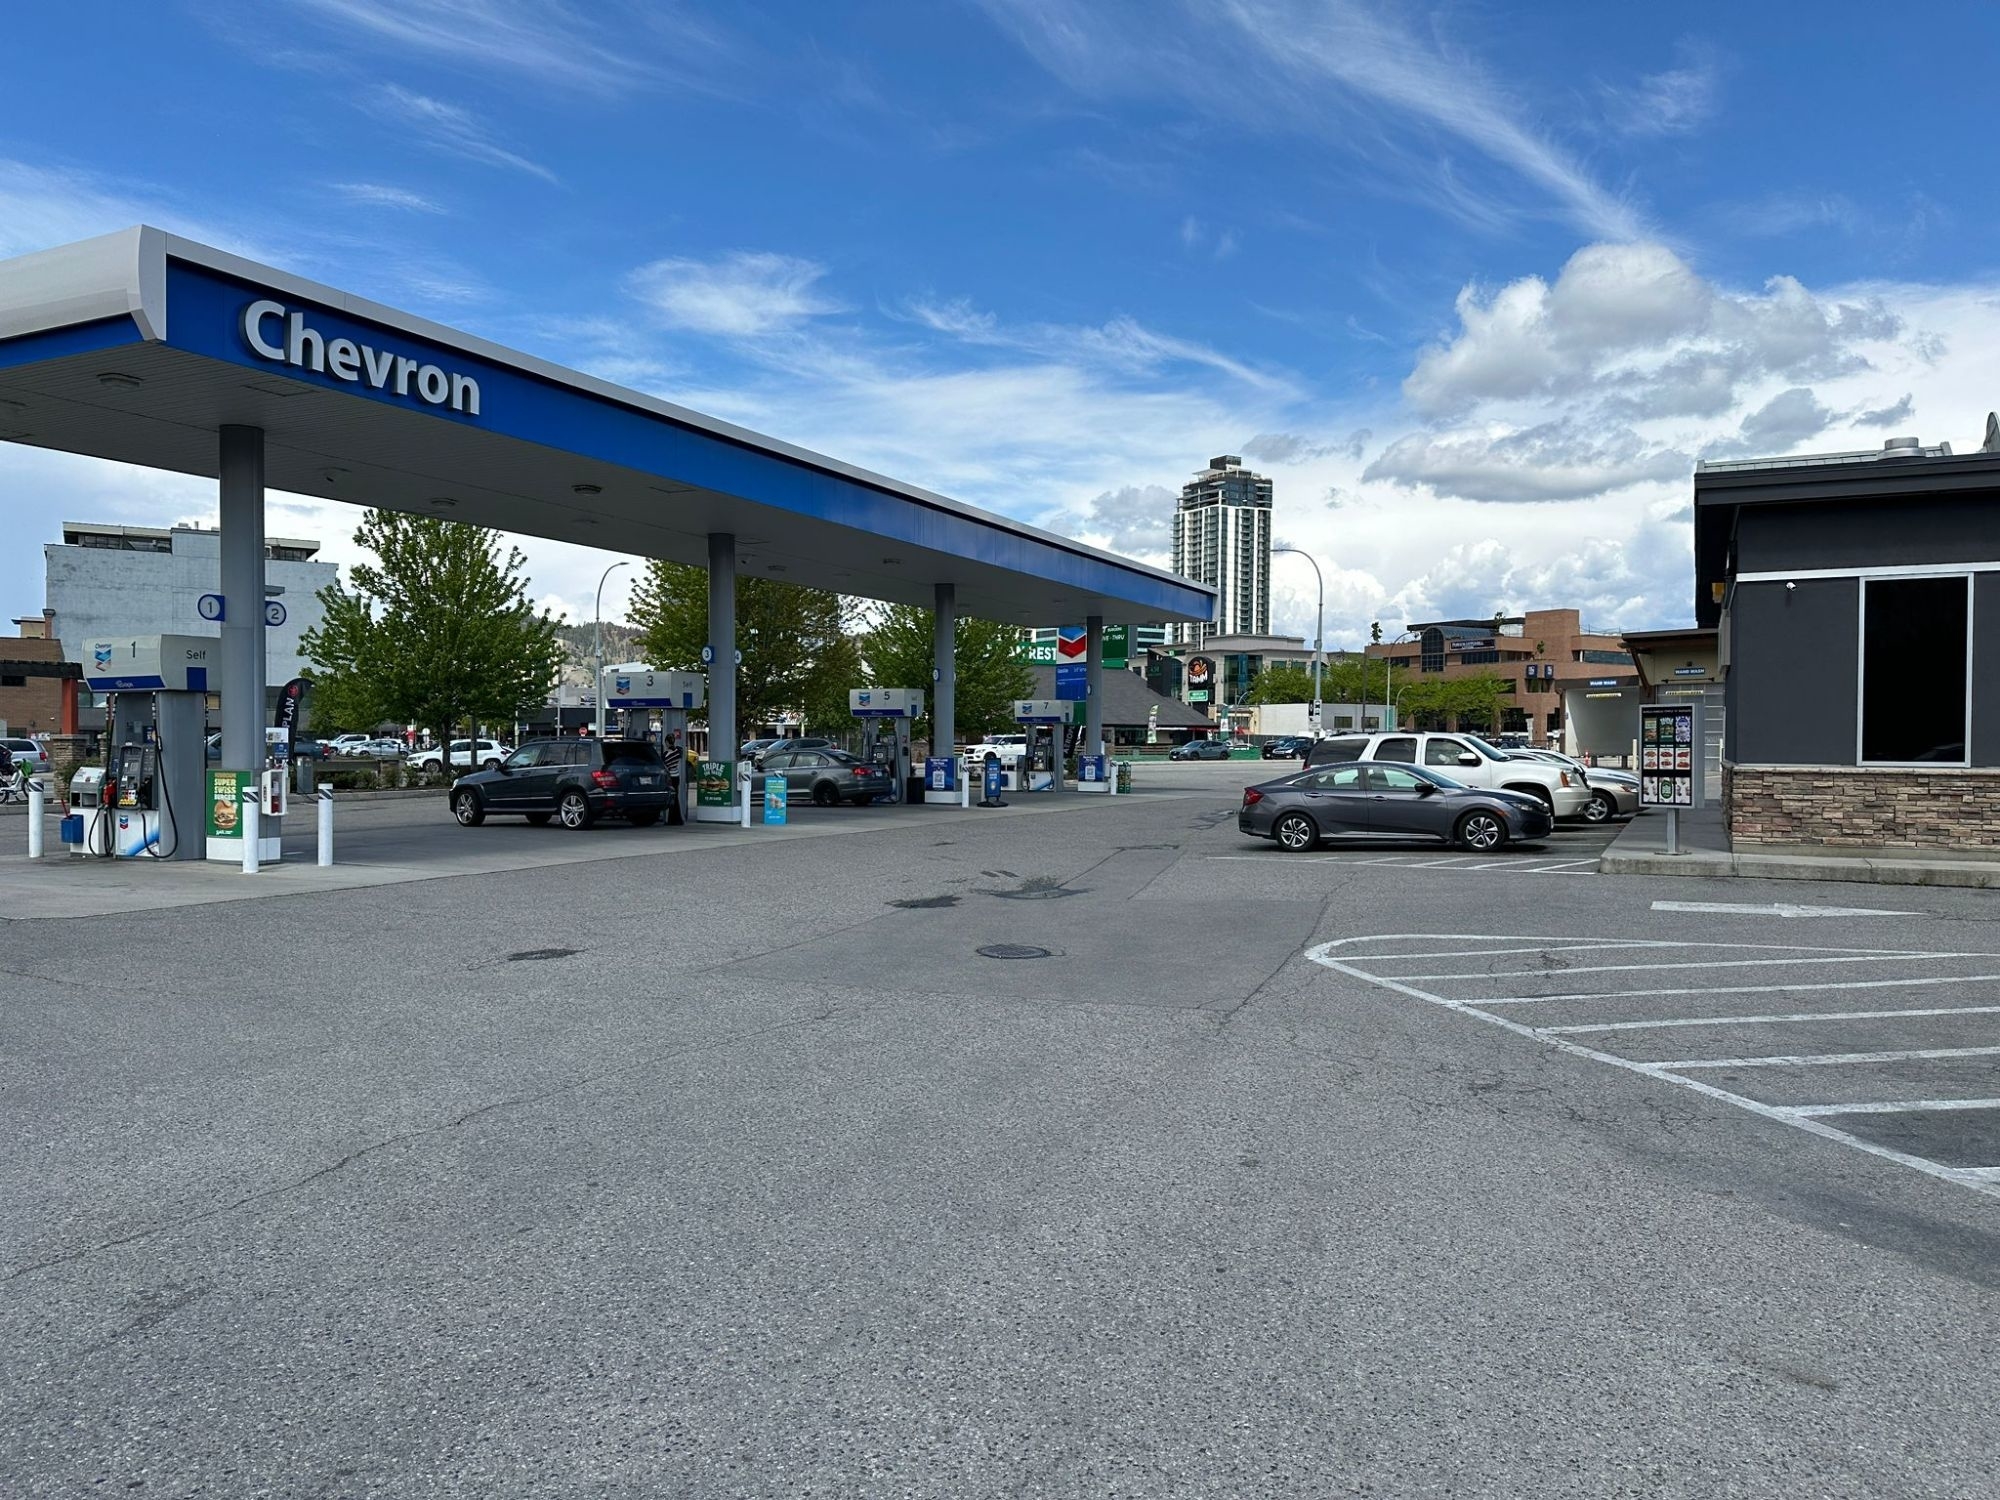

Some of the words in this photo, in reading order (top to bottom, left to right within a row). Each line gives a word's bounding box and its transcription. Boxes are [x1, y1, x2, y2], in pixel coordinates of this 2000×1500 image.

[244, 299, 481, 416] Chevron
[208, 601, 213, 613] 1
[271, 608, 279, 620] 2
[131, 641, 136, 658] 1
[704, 650, 710, 658] 3
[186, 650, 206, 660] Self
[647, 675, 654, 687] 3
[884, 691, 890, 700] 5
[1043, 702, 1049, 710] 7
[702, 762, 725, 773] TRIPLE
[214, 778, 236, 786] SUPER
[214, 786, 236, 794] SWISS
